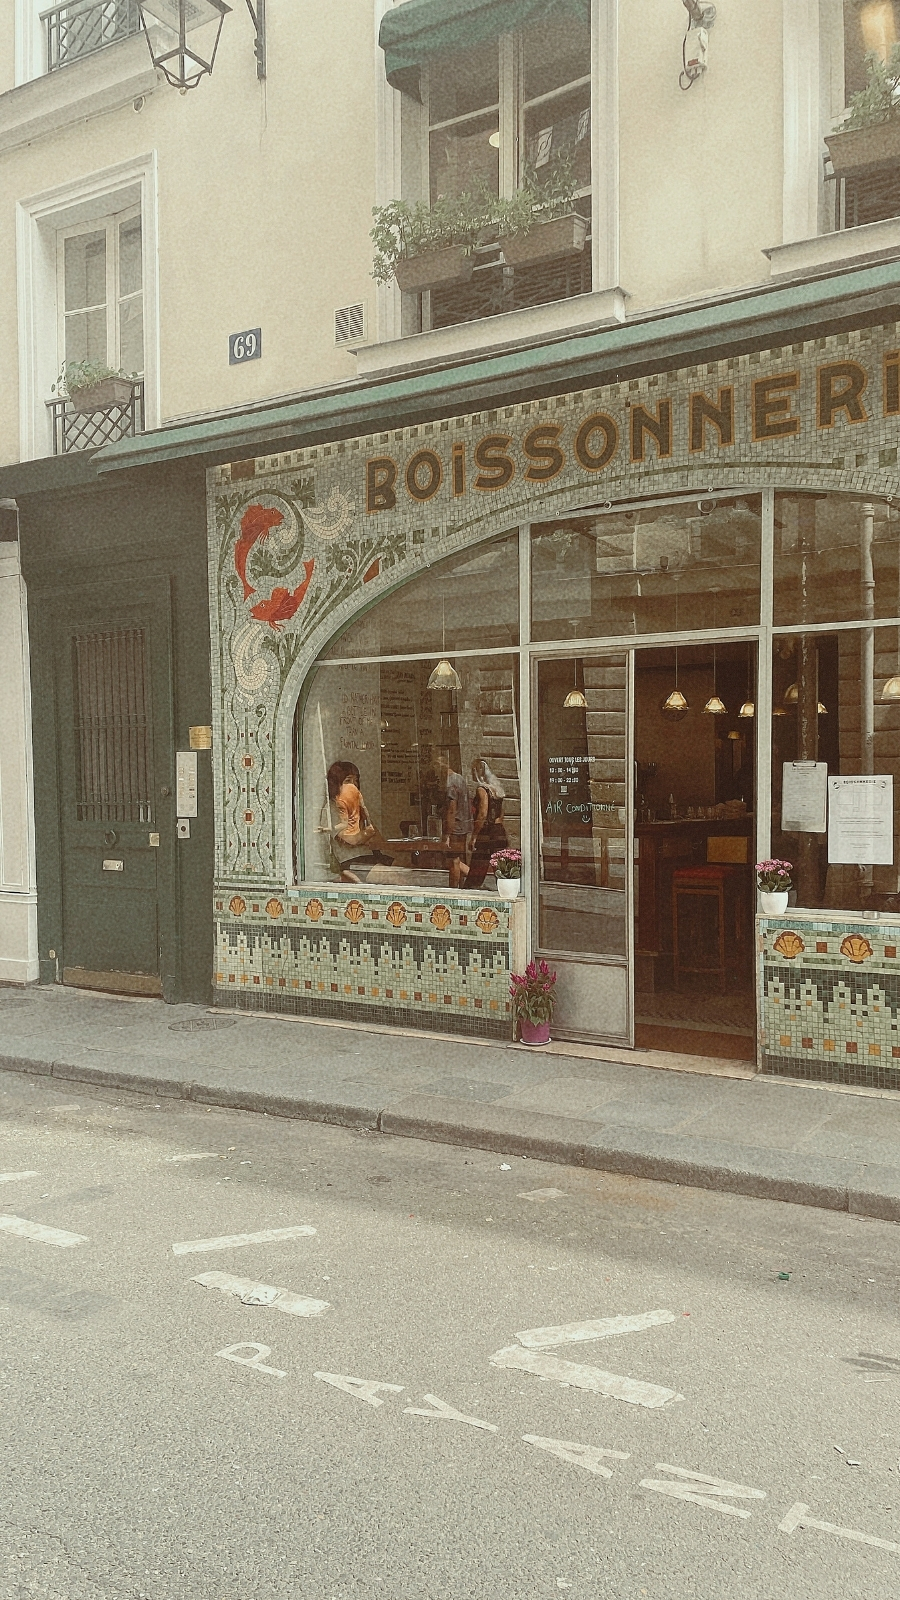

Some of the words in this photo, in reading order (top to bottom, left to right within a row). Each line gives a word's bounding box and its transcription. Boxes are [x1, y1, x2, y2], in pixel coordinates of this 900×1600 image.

[233, 333, 257, 359] 69
[545, 800, 563, 815] AIR
[214, 1341, 900, 1554] PAYANT
